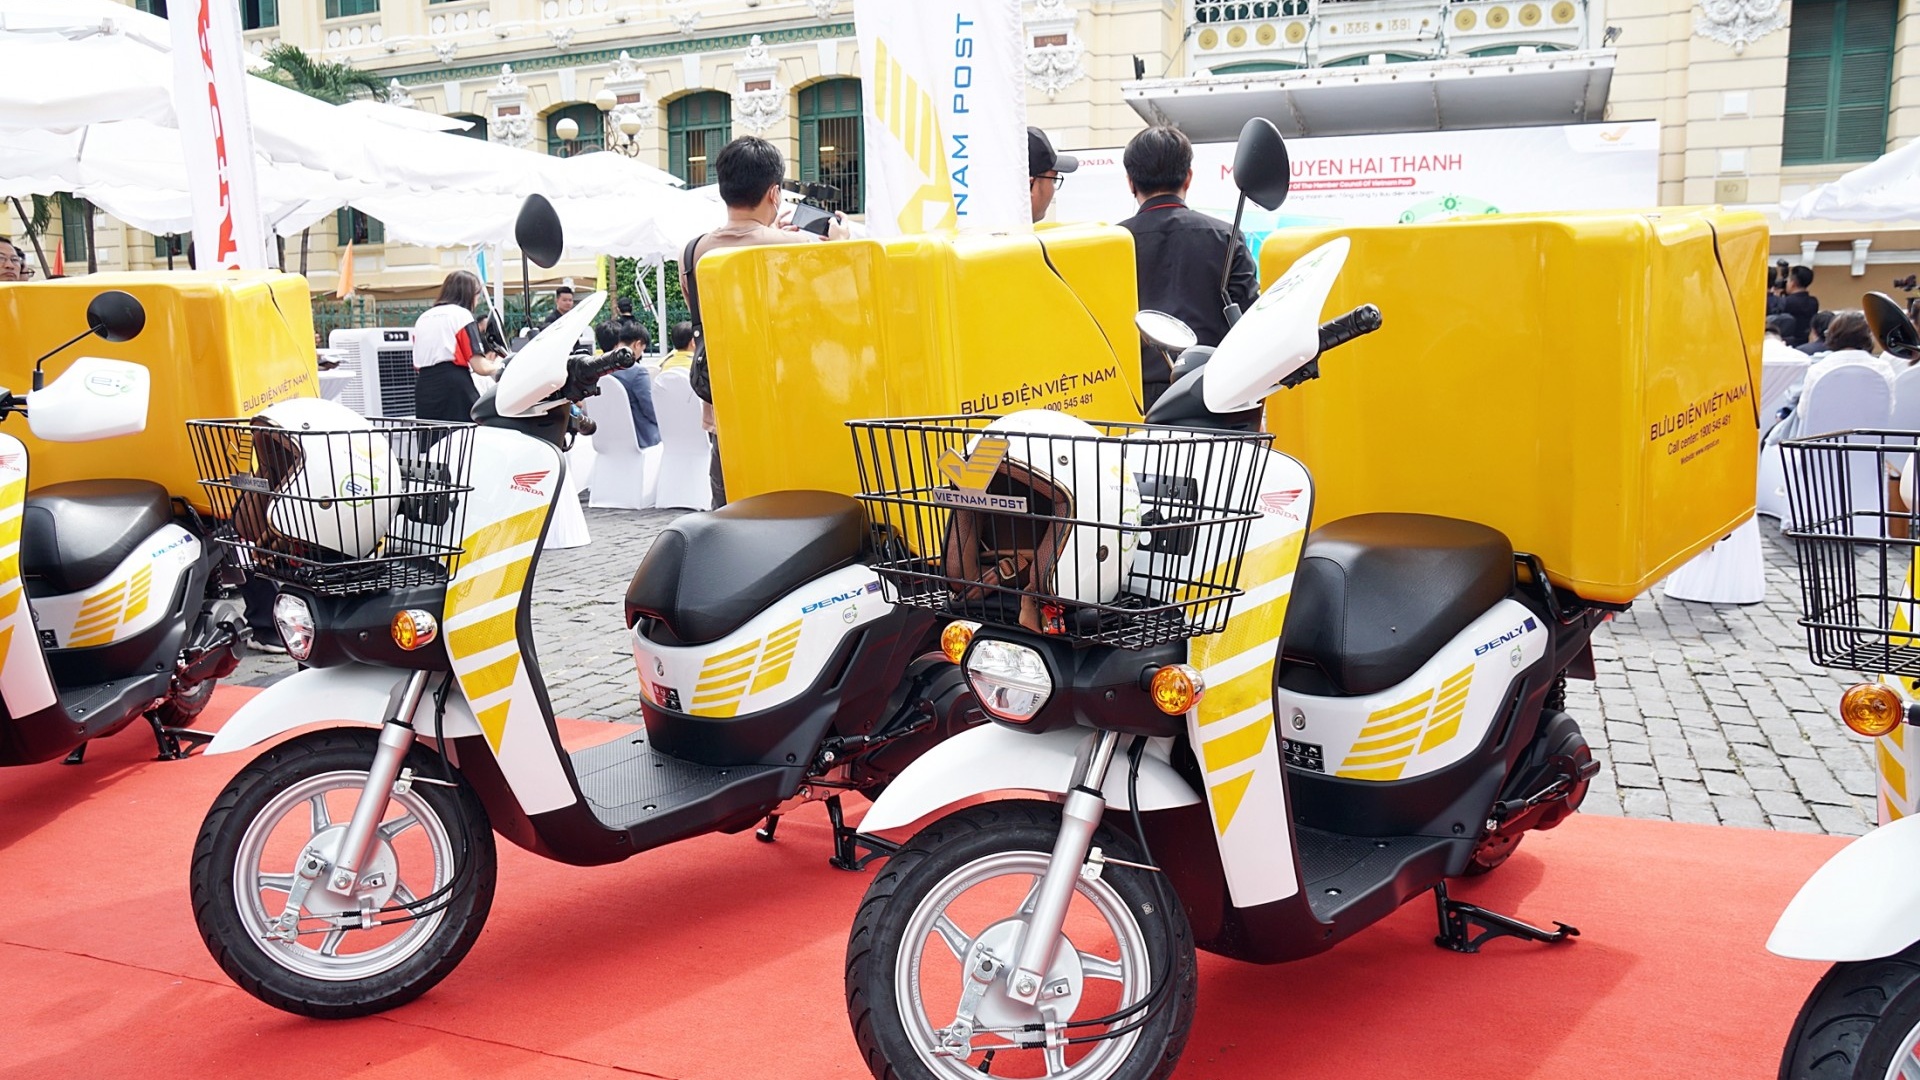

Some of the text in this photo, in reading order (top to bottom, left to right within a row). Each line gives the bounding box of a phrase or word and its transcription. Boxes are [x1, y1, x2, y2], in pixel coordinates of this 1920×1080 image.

[953, 13, 974, 114] POST
[1350, 158, 1384, 174] HAI
[1390, 154, 1462, 172] THANH
[293, 373, 308, 387] NAM
[961, 366, 1116, 415] BƯU ĐIỆN VIỆT NAM
[1064, 398, 1078, 410] 545
[1080, 392, 1094, 405] 481
[1650, 383, 1747, 441] BƯU ĐIỆN VIỆT NAM
[1668, 440, 1680, 455] Call
[1700, 423, 1712, 438] 1900
[510, 484, 544, 496] HONDA
[934, 492, 1024, 510] VIETNAM POST
[1258, 504, 1300, 521] HONDA
[801, 587, 864, 614] BENLY
[1474, 625, 1523, 656] BENLY
